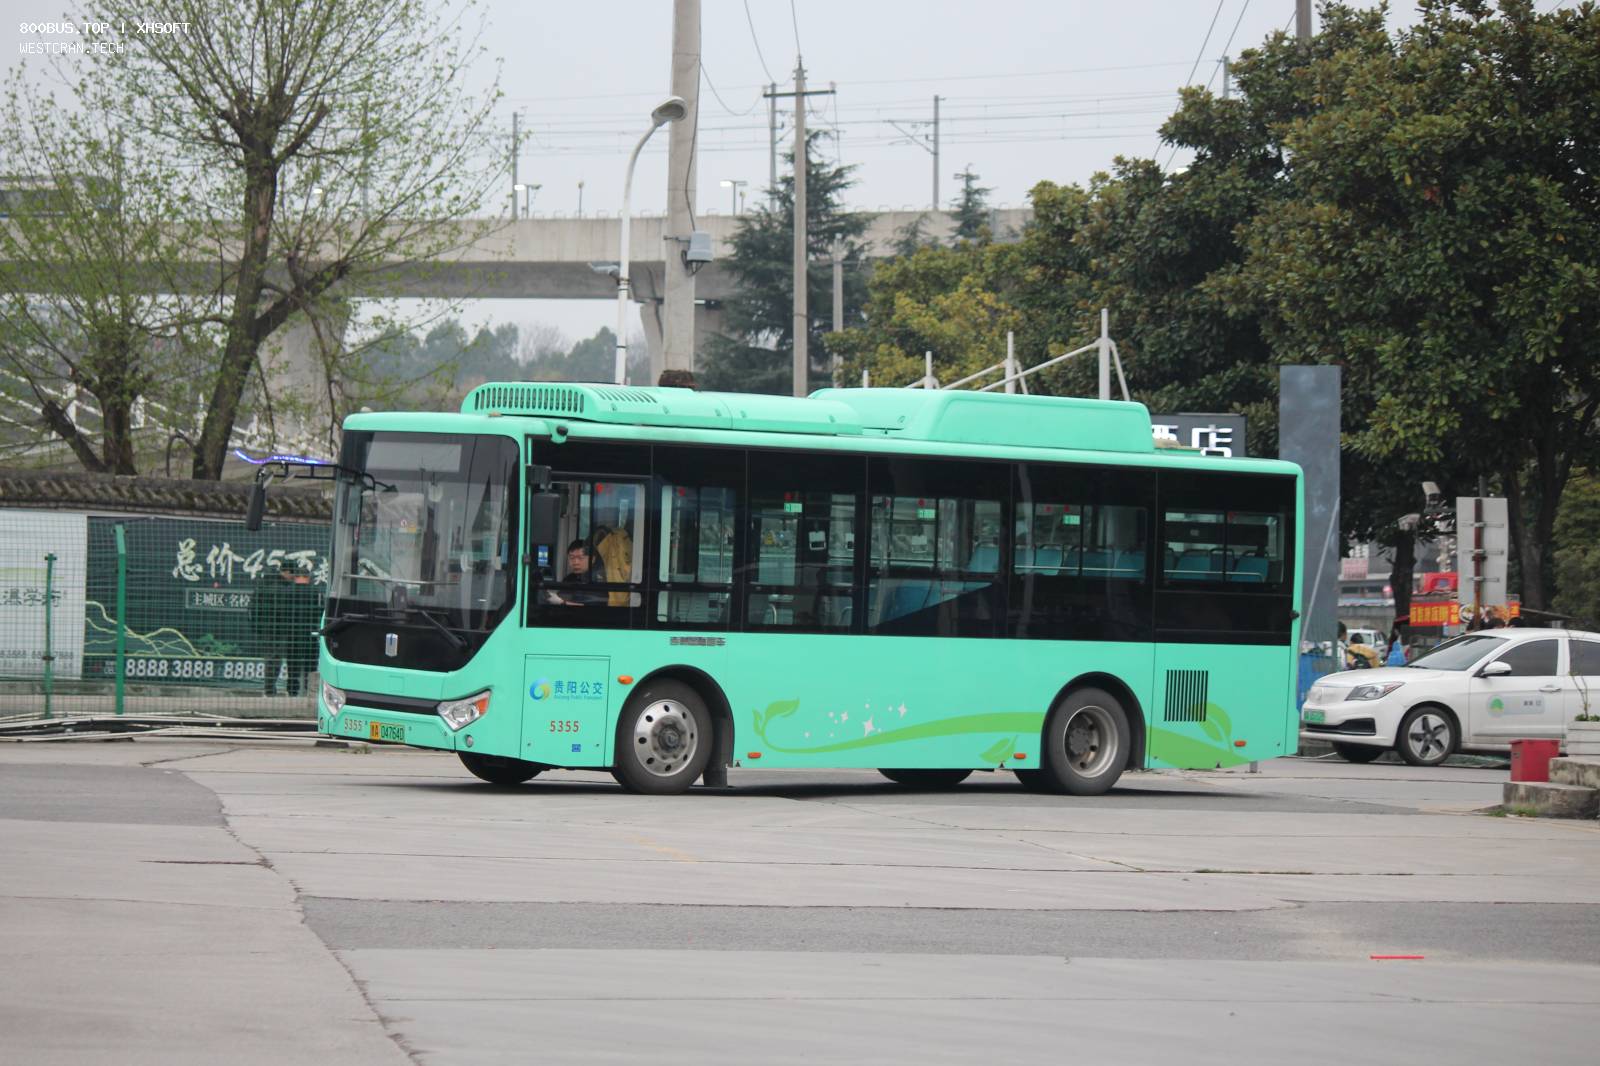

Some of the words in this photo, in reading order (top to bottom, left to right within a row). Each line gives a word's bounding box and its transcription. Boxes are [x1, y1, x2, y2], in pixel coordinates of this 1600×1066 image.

[125, 659, 168, 677] 8888
[172, 660, 214, 678] 3888
[223, 661, 266, 679] 8888
[553, 680, 604, 695] 贵阳公交
[344, 718, 363, 731] 5355
[550, 720, 579, 733] 5355
